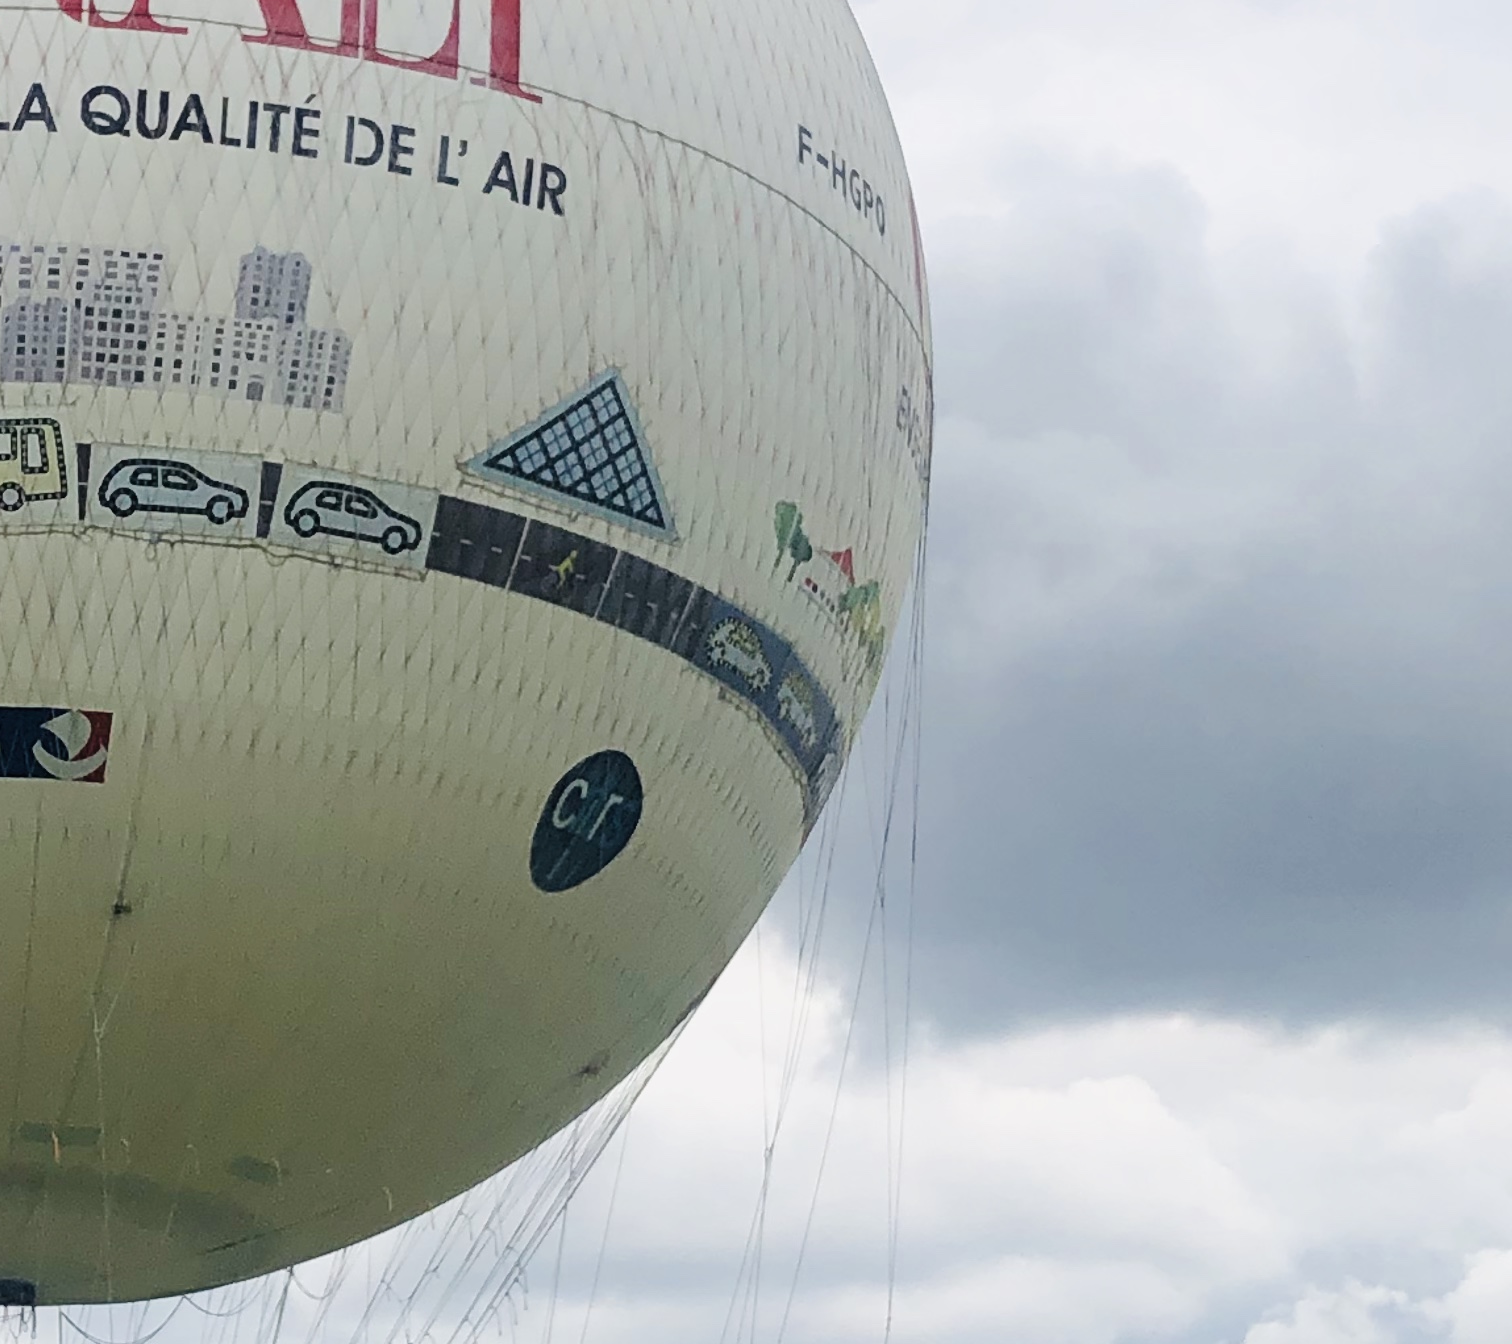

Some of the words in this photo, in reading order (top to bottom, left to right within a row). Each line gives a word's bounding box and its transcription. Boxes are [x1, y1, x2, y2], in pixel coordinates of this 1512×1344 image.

[80, 84, 319, 159] QUALITÉ
[344, 115, 413, 175] DE
[482, 151, 568, 216] AIR
[797, 123, 886, 238] F-HGPO
